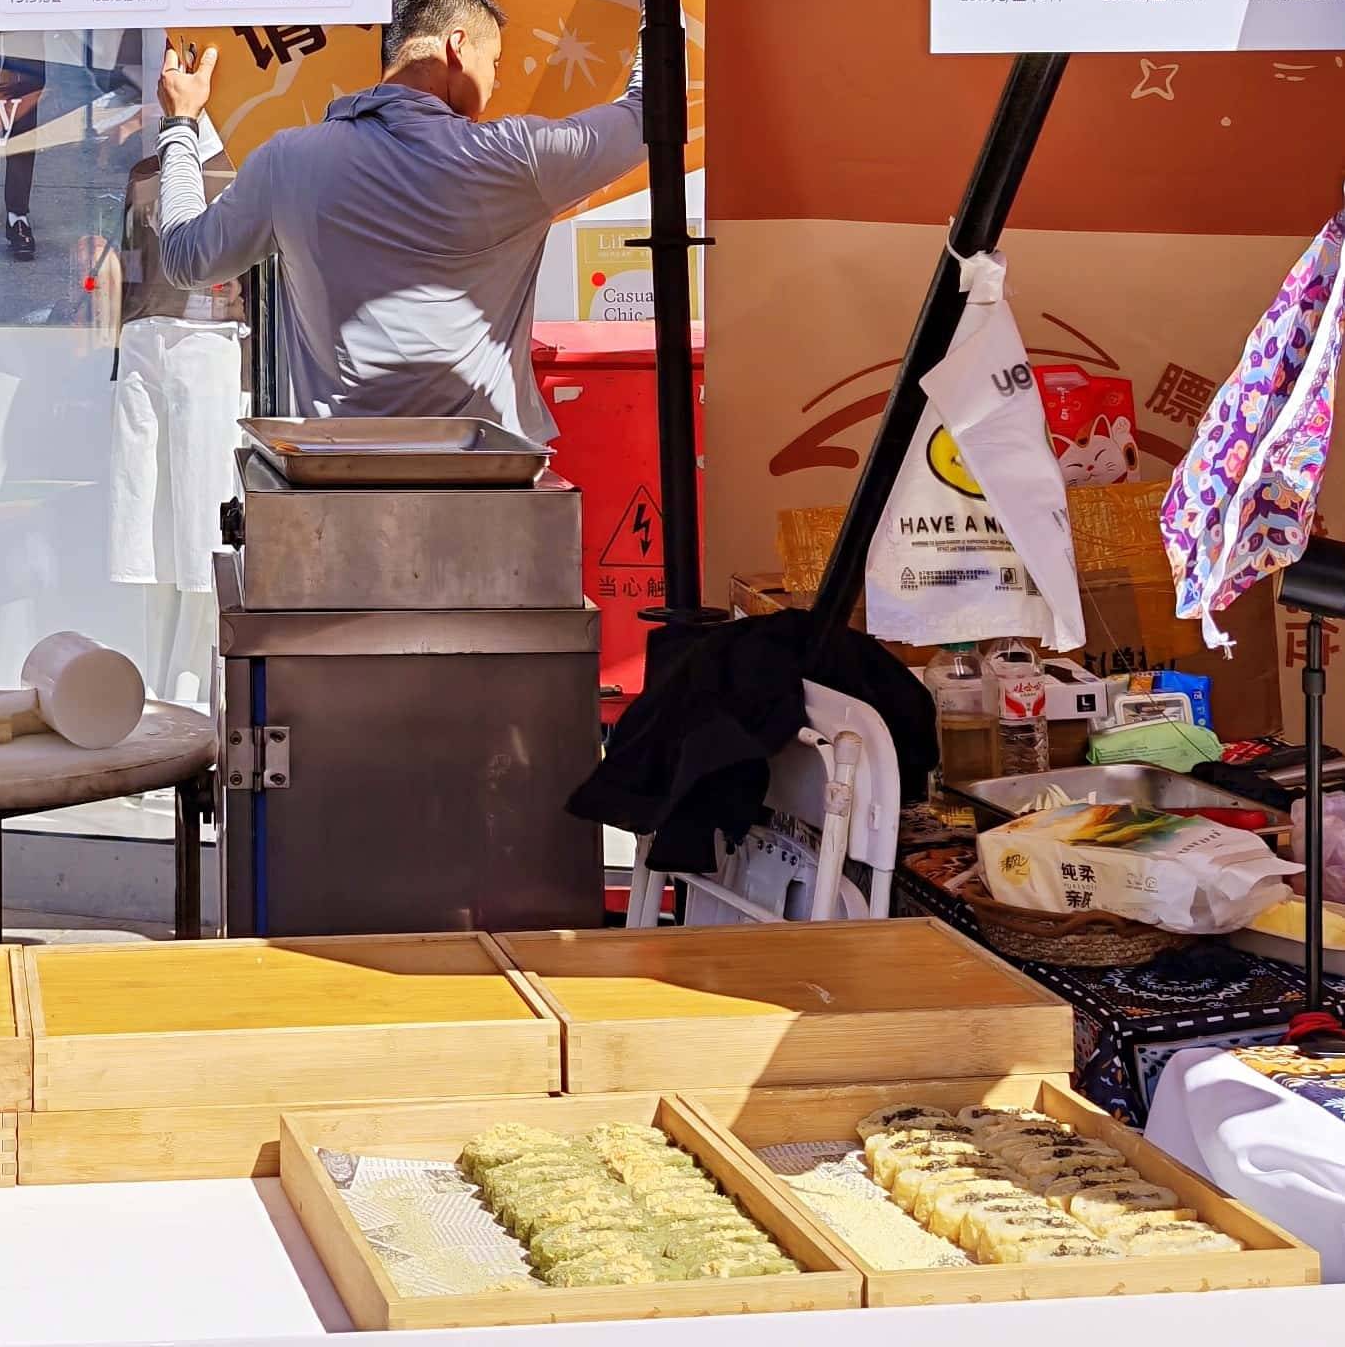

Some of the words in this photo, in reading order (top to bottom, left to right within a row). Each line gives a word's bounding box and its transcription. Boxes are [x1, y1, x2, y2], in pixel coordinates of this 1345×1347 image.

[900, 515, 955, 535] HAVE
[965, 516, 978, 533] A
[598, 575, 665, 598] 当心触
